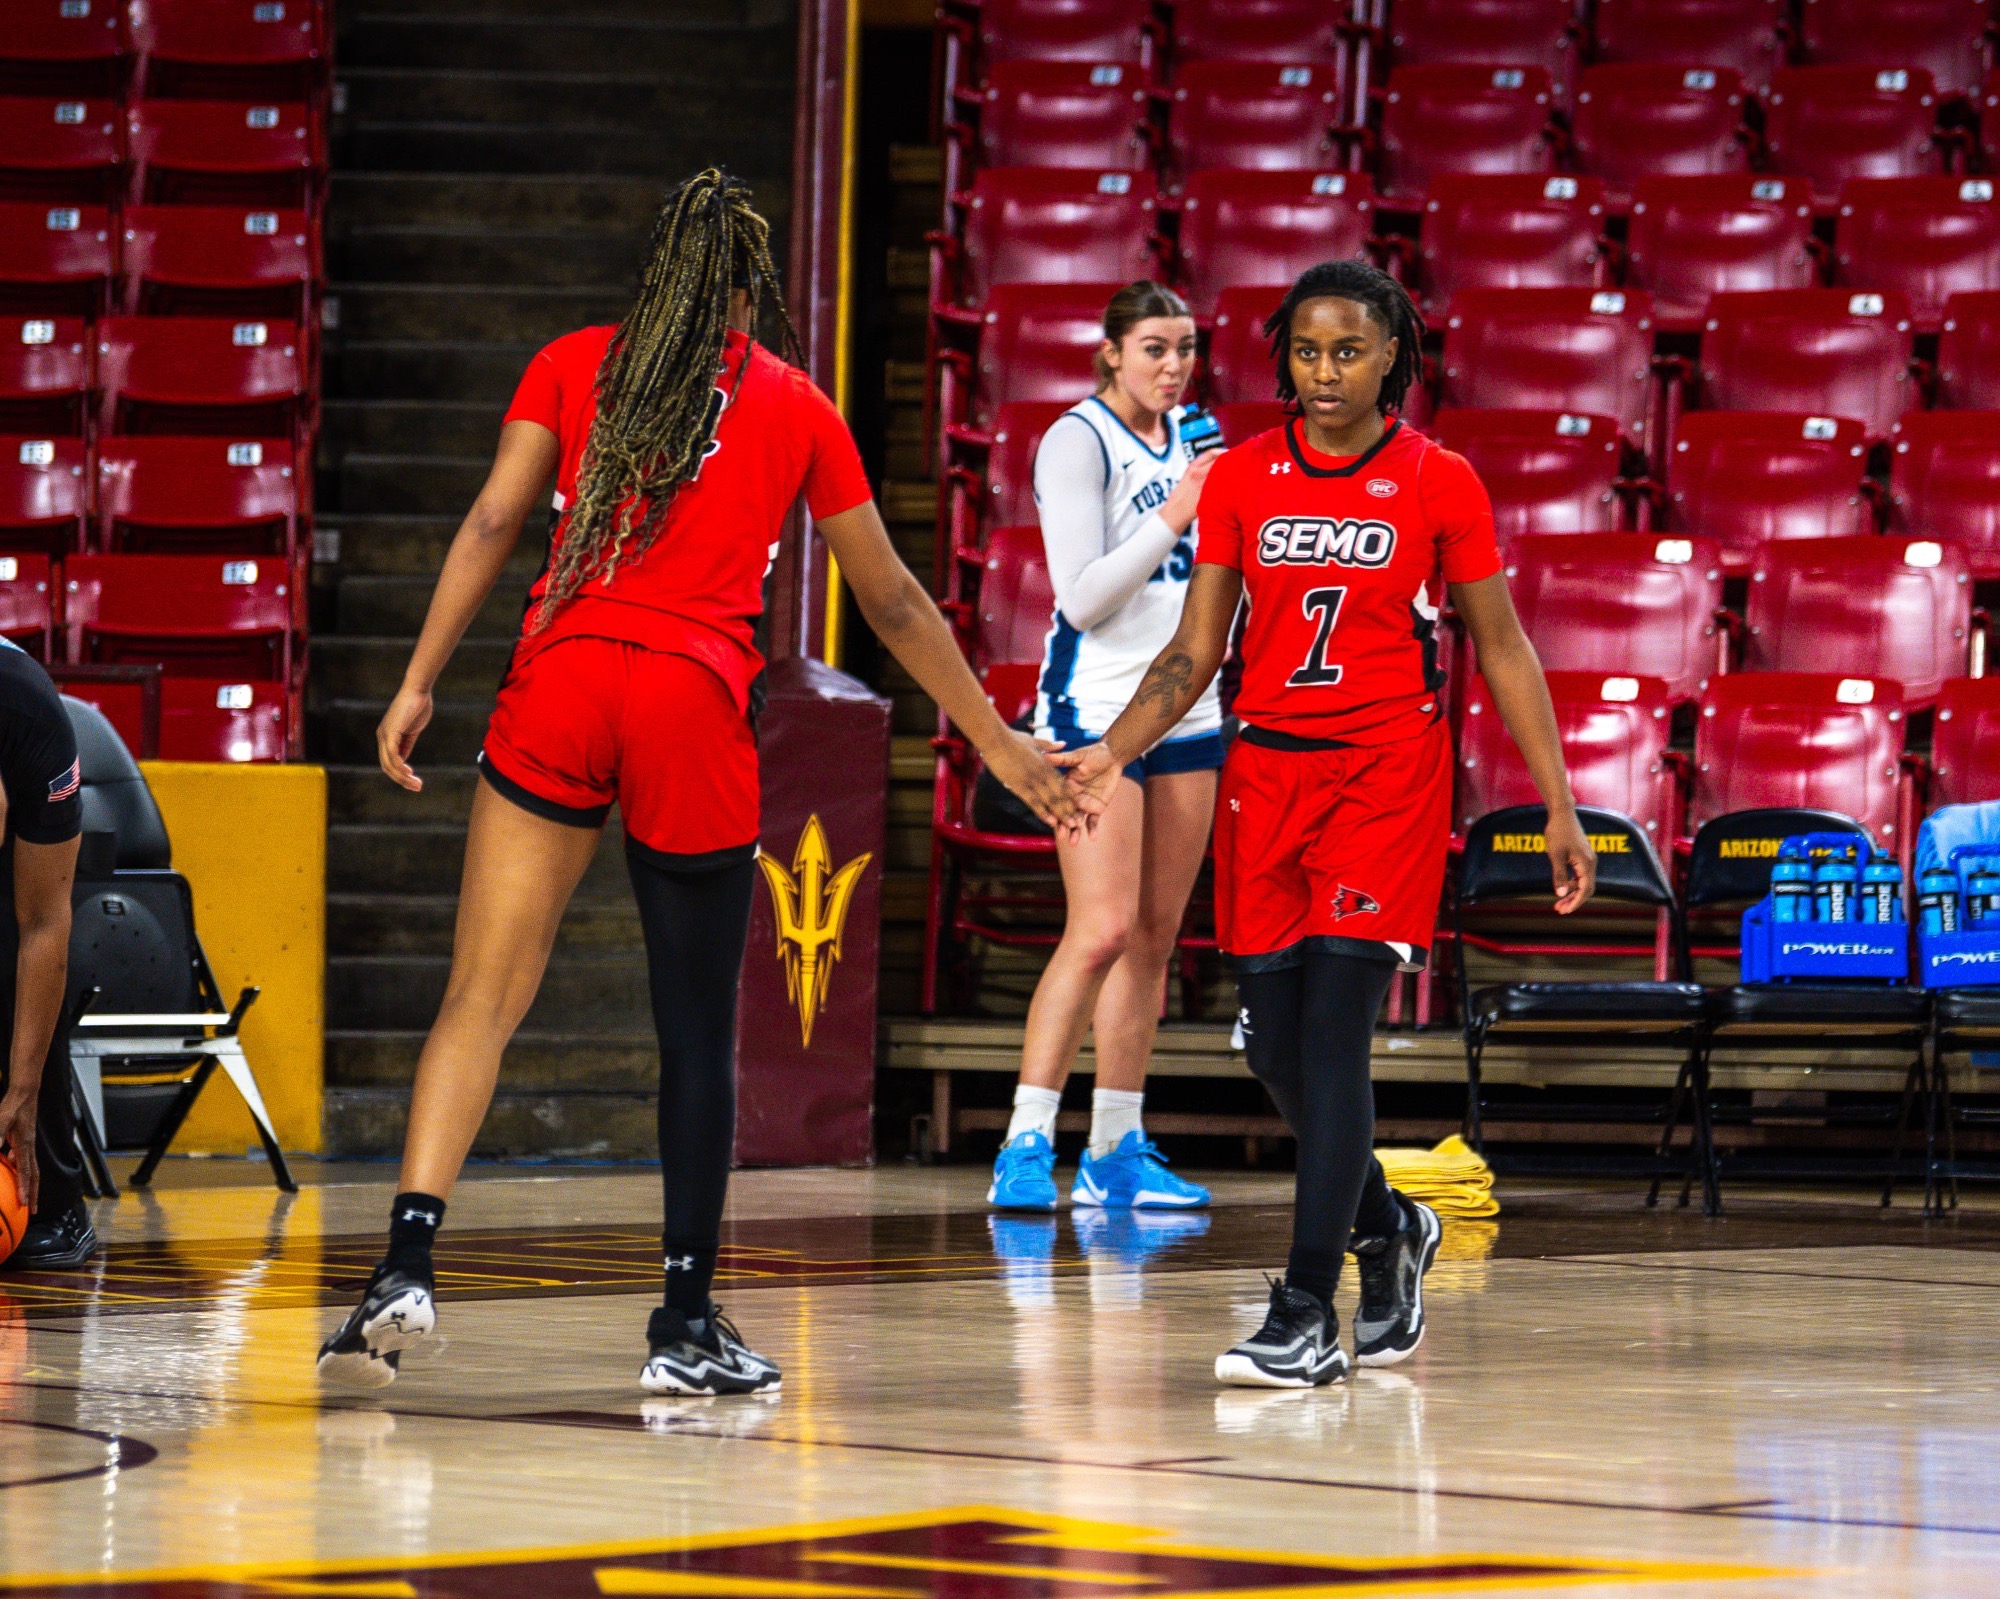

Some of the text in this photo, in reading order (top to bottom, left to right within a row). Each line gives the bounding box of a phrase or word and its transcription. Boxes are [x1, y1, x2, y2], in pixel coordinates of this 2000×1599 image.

[1147, 524, 1193, 582] 5
[1259, 518, 1395, 566] SEMO
[1493, 834, 1630, 853] ARIZO TATE
[1719, 839, 1782, 858] ARIZON
[1831, 882, 1846, 924] RADE
[1877, 882, 1892, 924] RADE
[1931, 951, 2000, 967] POWE
